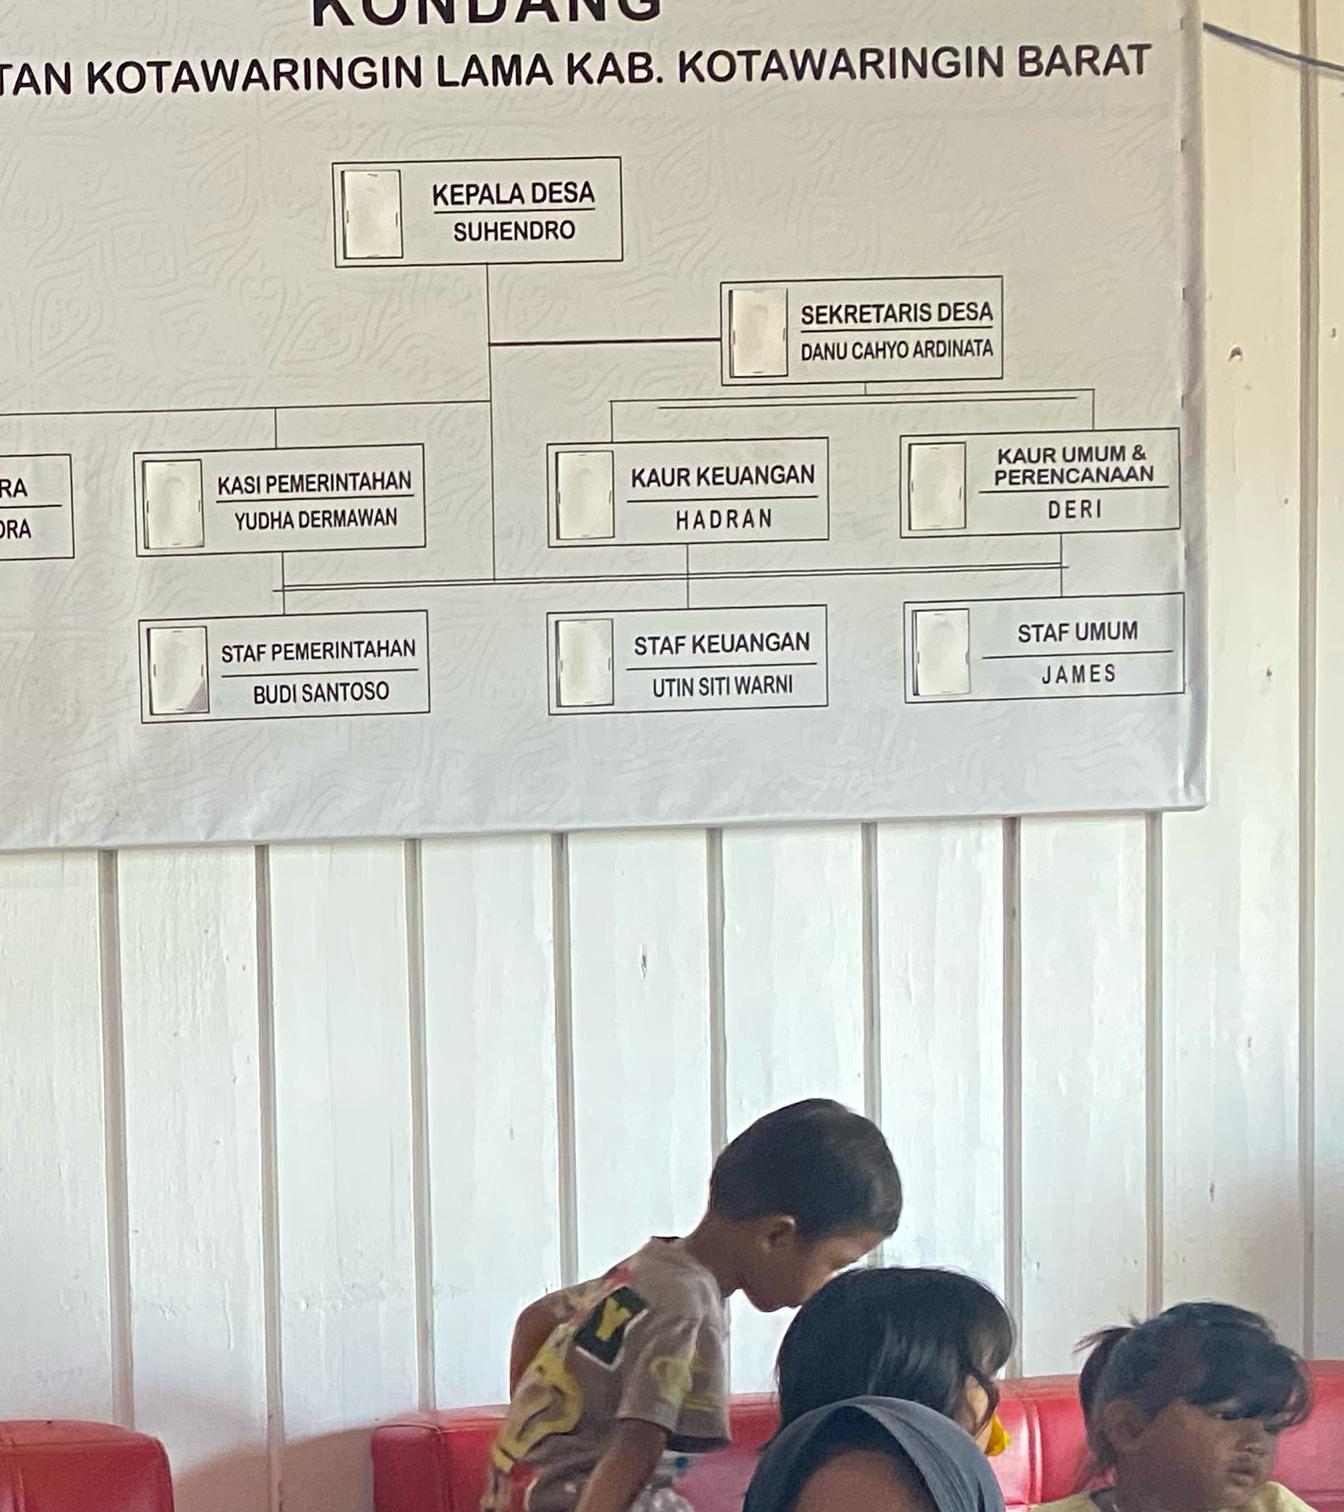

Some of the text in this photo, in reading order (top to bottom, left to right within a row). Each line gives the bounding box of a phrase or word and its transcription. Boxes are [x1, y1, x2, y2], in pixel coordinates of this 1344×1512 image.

[87, 54, 422, 95] KOTAWARINGIN
[437, 52, 554, 87] LAMA
[567, 51, 663, 85] KAB.
[678, 45, 1003, 83] KOTAWARINGIN
[1018, 43, 1152, 77] BARAT
[432, 180, 595, 206] KEPALA DESA
[454, 219, 575, 242] SUHENDRO
[801, 301, 994, 325] SEKRETARIS DESA
[801, 338, 994, 361] DANU CAHYO ARDINATA
[998, 444, 1146, 465] KAUR UMUM &
[218, 470, 411, 495] KASI PEMERINTAHAN
[631, 464, 814, 488] KAUR KEUANGAN
[994, 465, 1154, 486] PERENCANAAN
[234, 507, 397, 531] YUDHA DERMAWAN
[676, 508, 771, 530] HADRAN
[1048, 498, 1101, 519] DERI
[634, 631, 810, 656] STAF KEUANGAN
[1018, 620, 1138, 643] STAF UMUM
[221, 638, 415, 663] STAF PEMERINTAHAN
[1041, 663, 1115, 684] JAMES
[253, 680, 389, 705] BUDI SANTOSO
[653, 674, 792, 698] UTIN SITI WARNI
